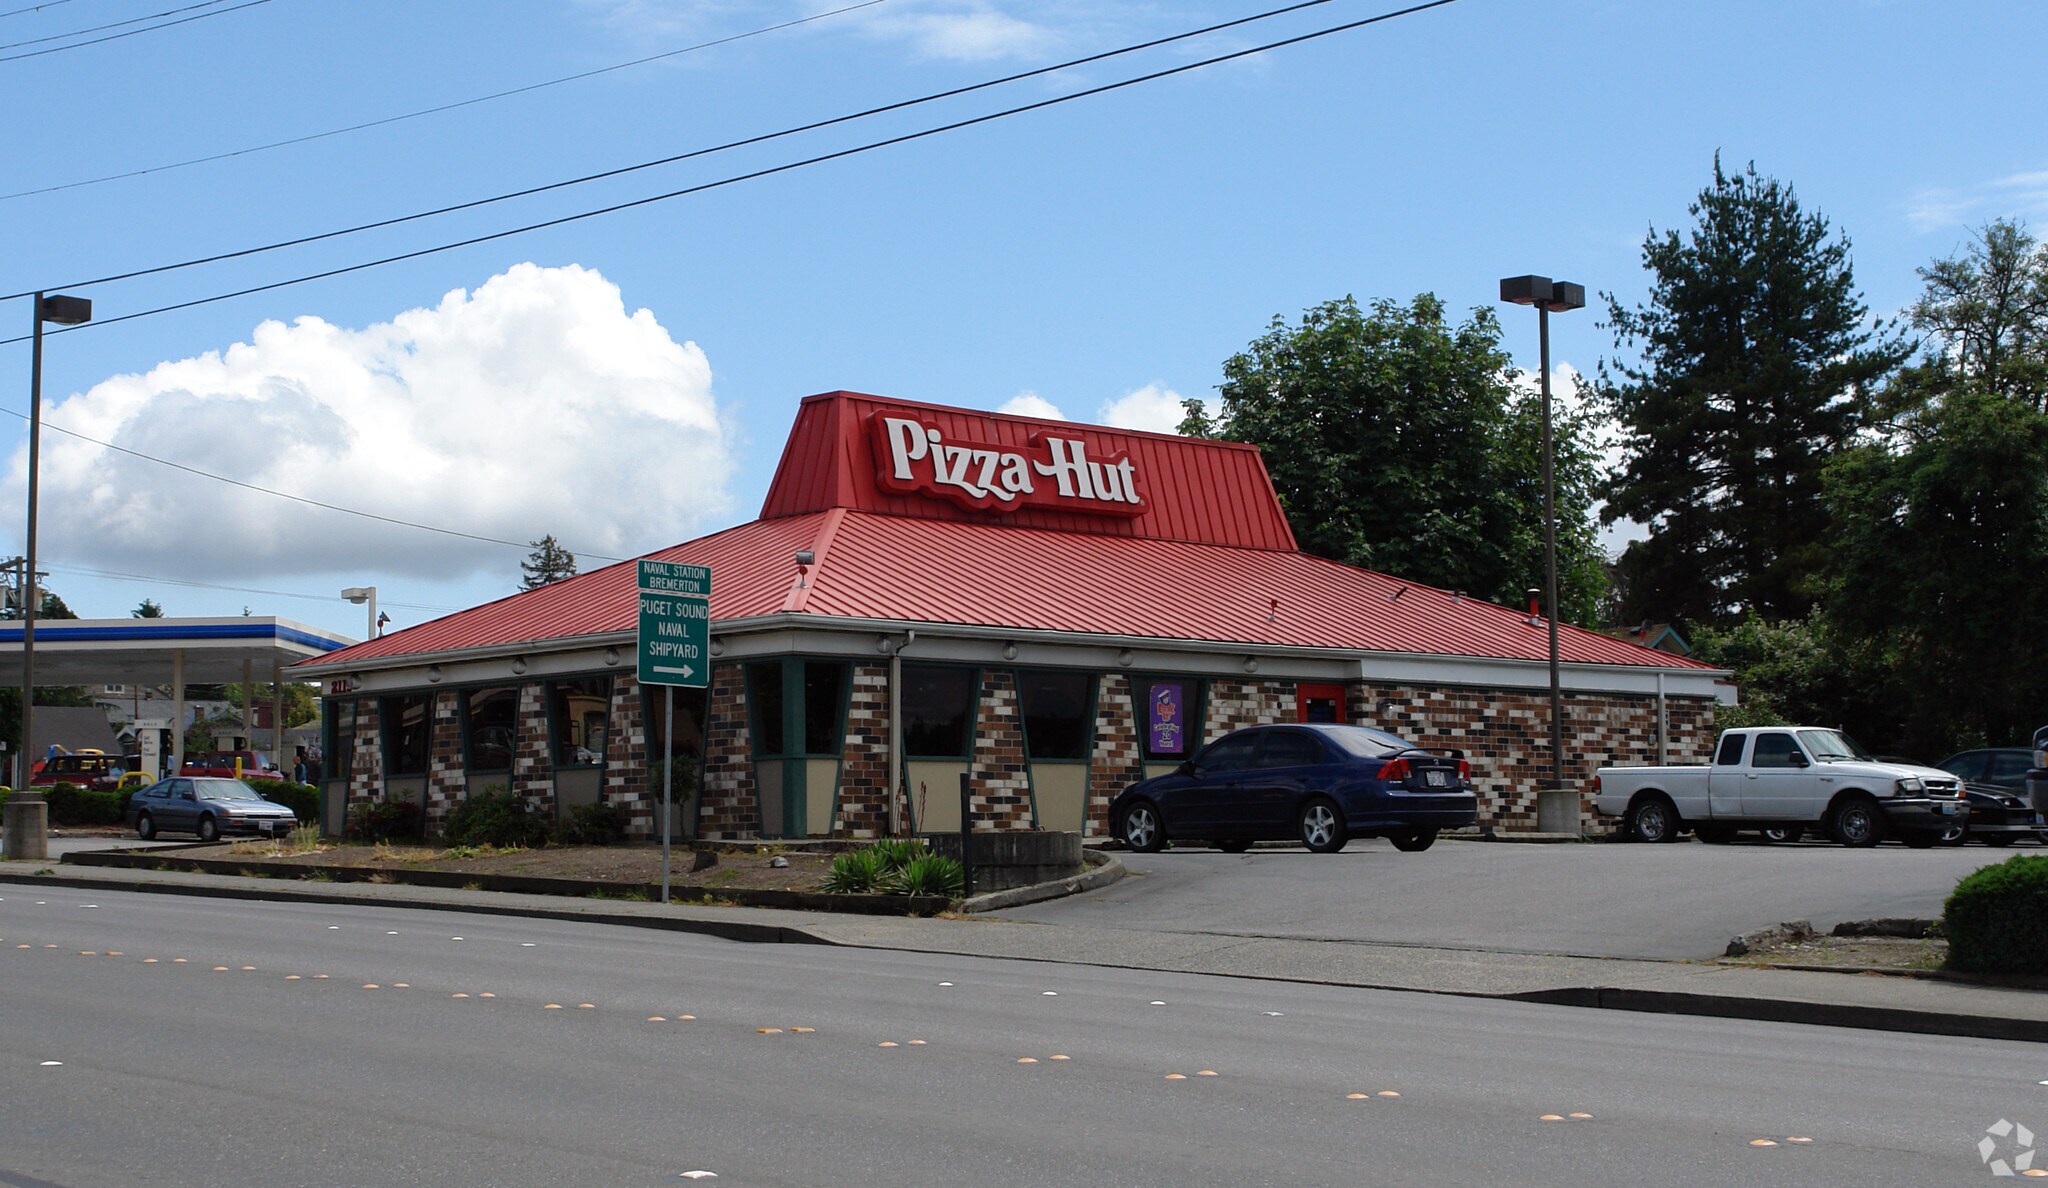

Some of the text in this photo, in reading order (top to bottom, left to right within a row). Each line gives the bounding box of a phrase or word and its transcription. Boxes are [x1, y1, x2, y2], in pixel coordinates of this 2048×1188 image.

[884, 417, 1141, 505] Pizza Hut
[644, 562, 705, 579] NAVAL STATION
[650, 577, 700, 592] BREMERTON
[640, 600, 708, 619] PUGET SOUND
[658, 622, 689, 637] NAVAL
[649, 641, 698, 658] SHIPYARD
